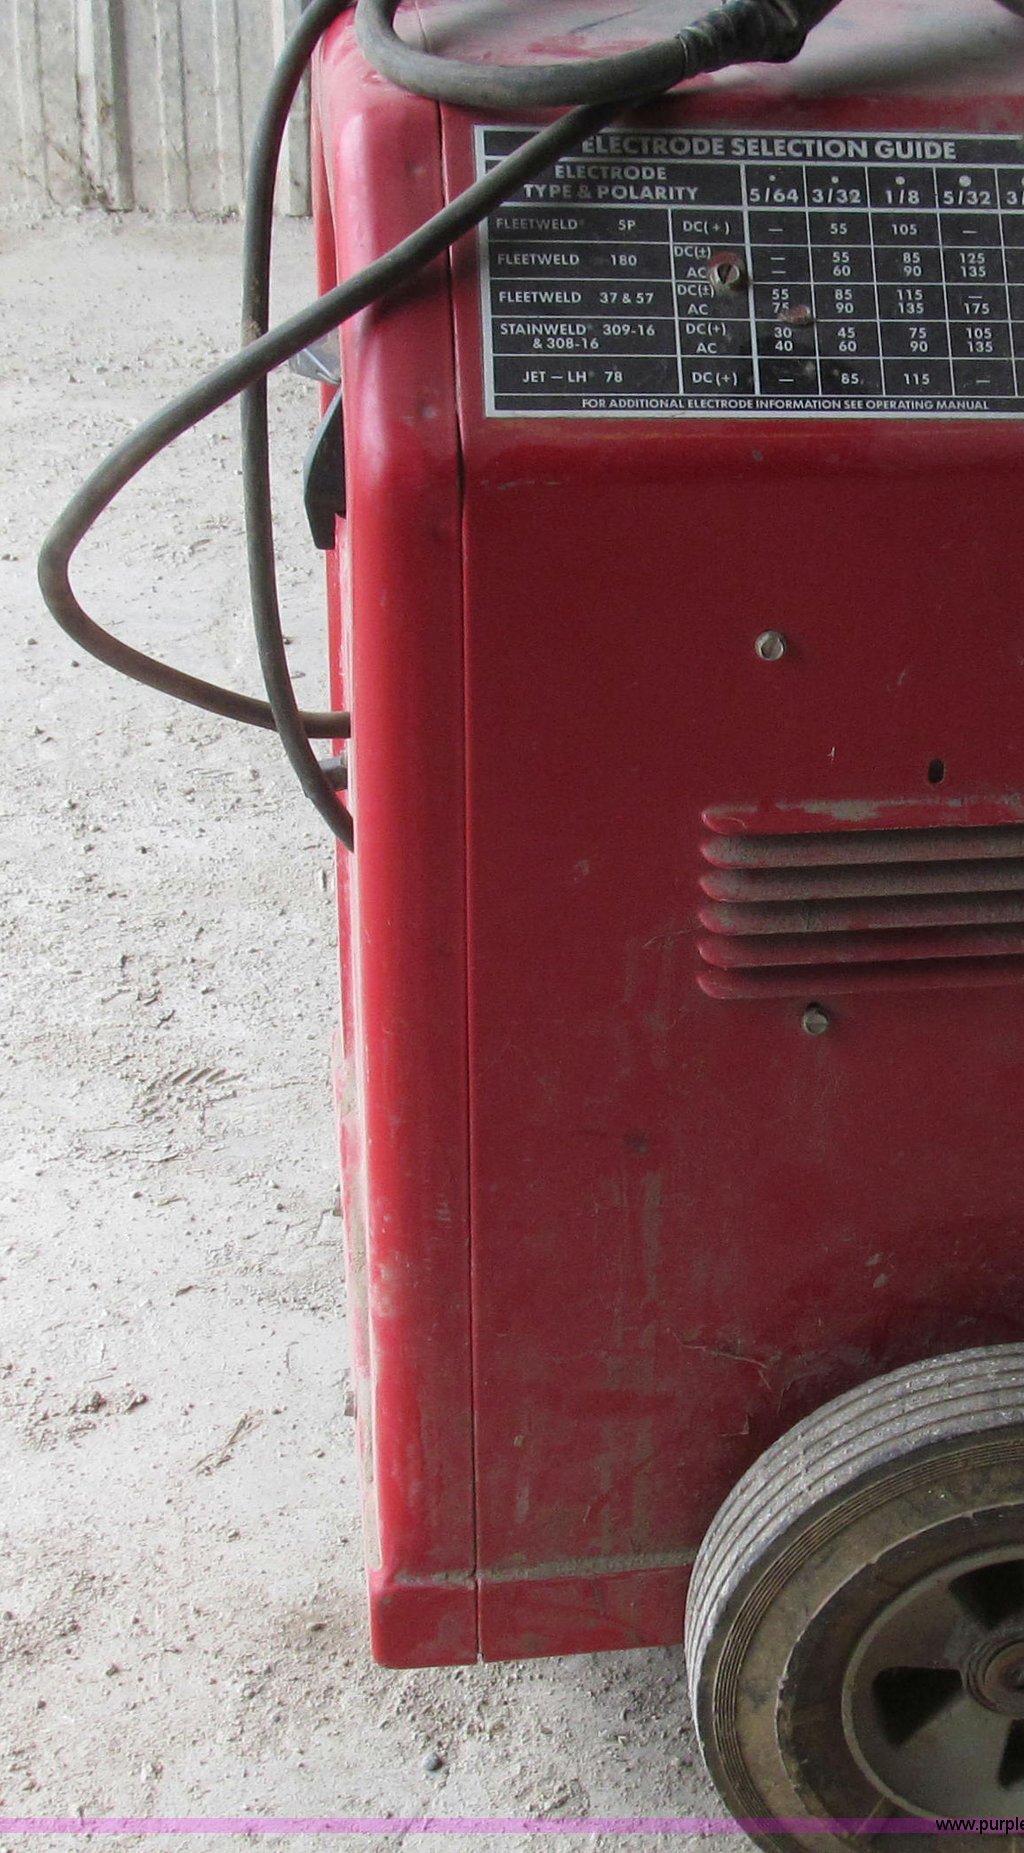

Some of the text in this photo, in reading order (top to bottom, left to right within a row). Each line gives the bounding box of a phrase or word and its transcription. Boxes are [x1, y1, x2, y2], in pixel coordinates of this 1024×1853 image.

[581, 135, 957, 160] ELECTRODE SELECTION GUIDE
[554, 165, 667, 180] ELECTRODE
[523, 183, 699, 200] TYPE & POLARITY
[749, 187, 799, 203] 5/64
[811, 188, 861, 204] 3/32
[885, 189, 920, 204] 1/8
[943, 190, 991, 206] 5/32
[496, 217, 578, 230] FLEETWELD
[829, 223, 848, 235] 55
[891, 224, 918, 236] 105
[497, 253, 638, 267] FLEETWELD 180
[831, 252, 850, 264] 55
[902, 252, 921, 264] 85
[959, 252, 986, 264] 125
[686, 266, 707, 279] AC
[832, 265, 852, 278] 60
[903, 265, 922, 277] 90
[960, 266, 987, 278] 135
[499, 291, 654, 304] FLEETWELD 37 & 57
[771, 288, 790, 301] 55
[834, 288, 853, 301] 85
[896, 289, 923, 301] 115
[687, 303, 709, 316] AC
[836, 302, 854, 314] 90
[898, 303, 925, 315] 135
[963, 303, 990, 315] 175
[500, 323, 656, 337] STAINWELD 309-16
[774, 327, 793, 339] 30
[837, 327, 856, 339] 45
[908, 327, 927, 339] 75
[965, 328, 992, 340] 105
[532, 338, 600, 350] & 308-16
[695, 342, 718, 355] AC
[774, 340, 794, 352] 40
[838, 341, 857, 353] 60
[910, 341, 929, 353] 90
[966, 342, 993, 353] 135
[522, 371, 547, 383] JET
[604, 371, 624, 383] 78
[903, 373, 930, 385] 115
[582, 398, 990, 411] FOR ADDITIONAL ELECTRODE INFORMATION SEE OPERATING MANUAL
